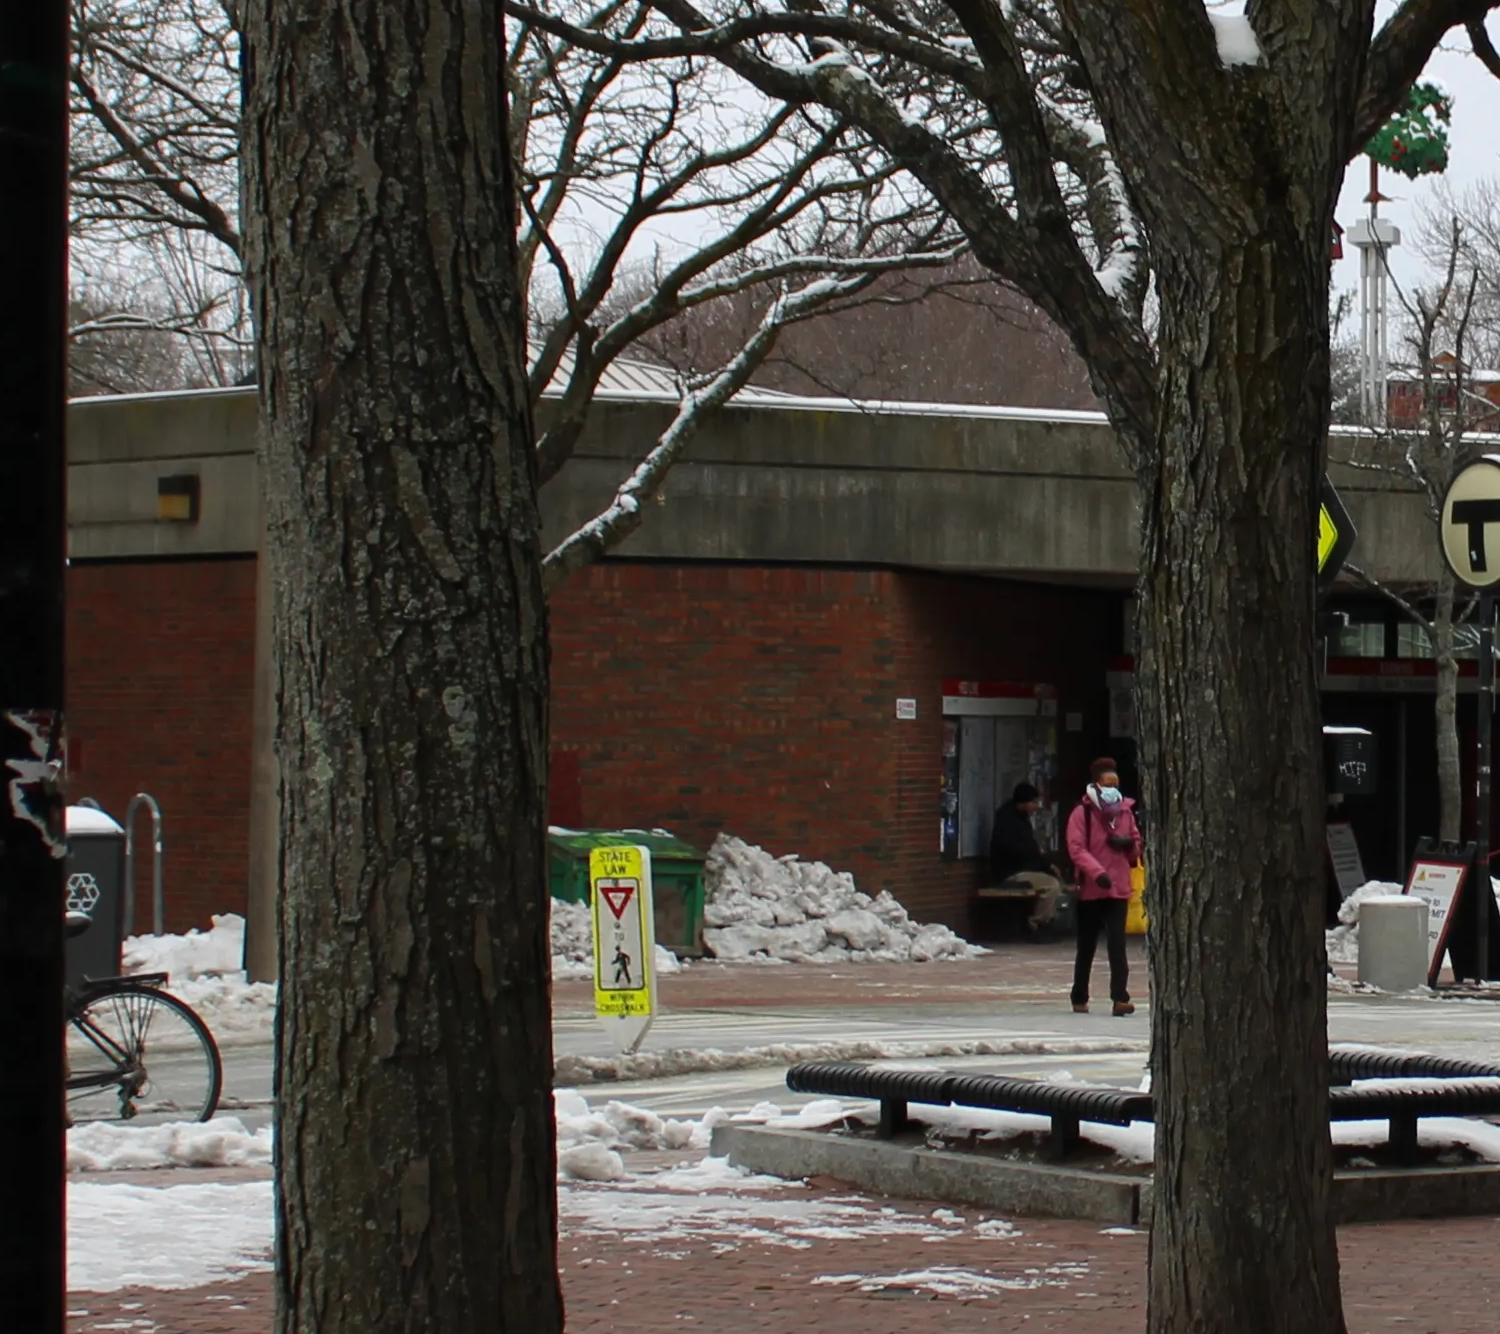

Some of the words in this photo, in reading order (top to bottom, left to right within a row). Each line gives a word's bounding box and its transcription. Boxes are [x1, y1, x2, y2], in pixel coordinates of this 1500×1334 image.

[599, 851, 632, 863] STATE
[604, 865, 627, 876] LAW
[614, 932, 625, 942] TO
